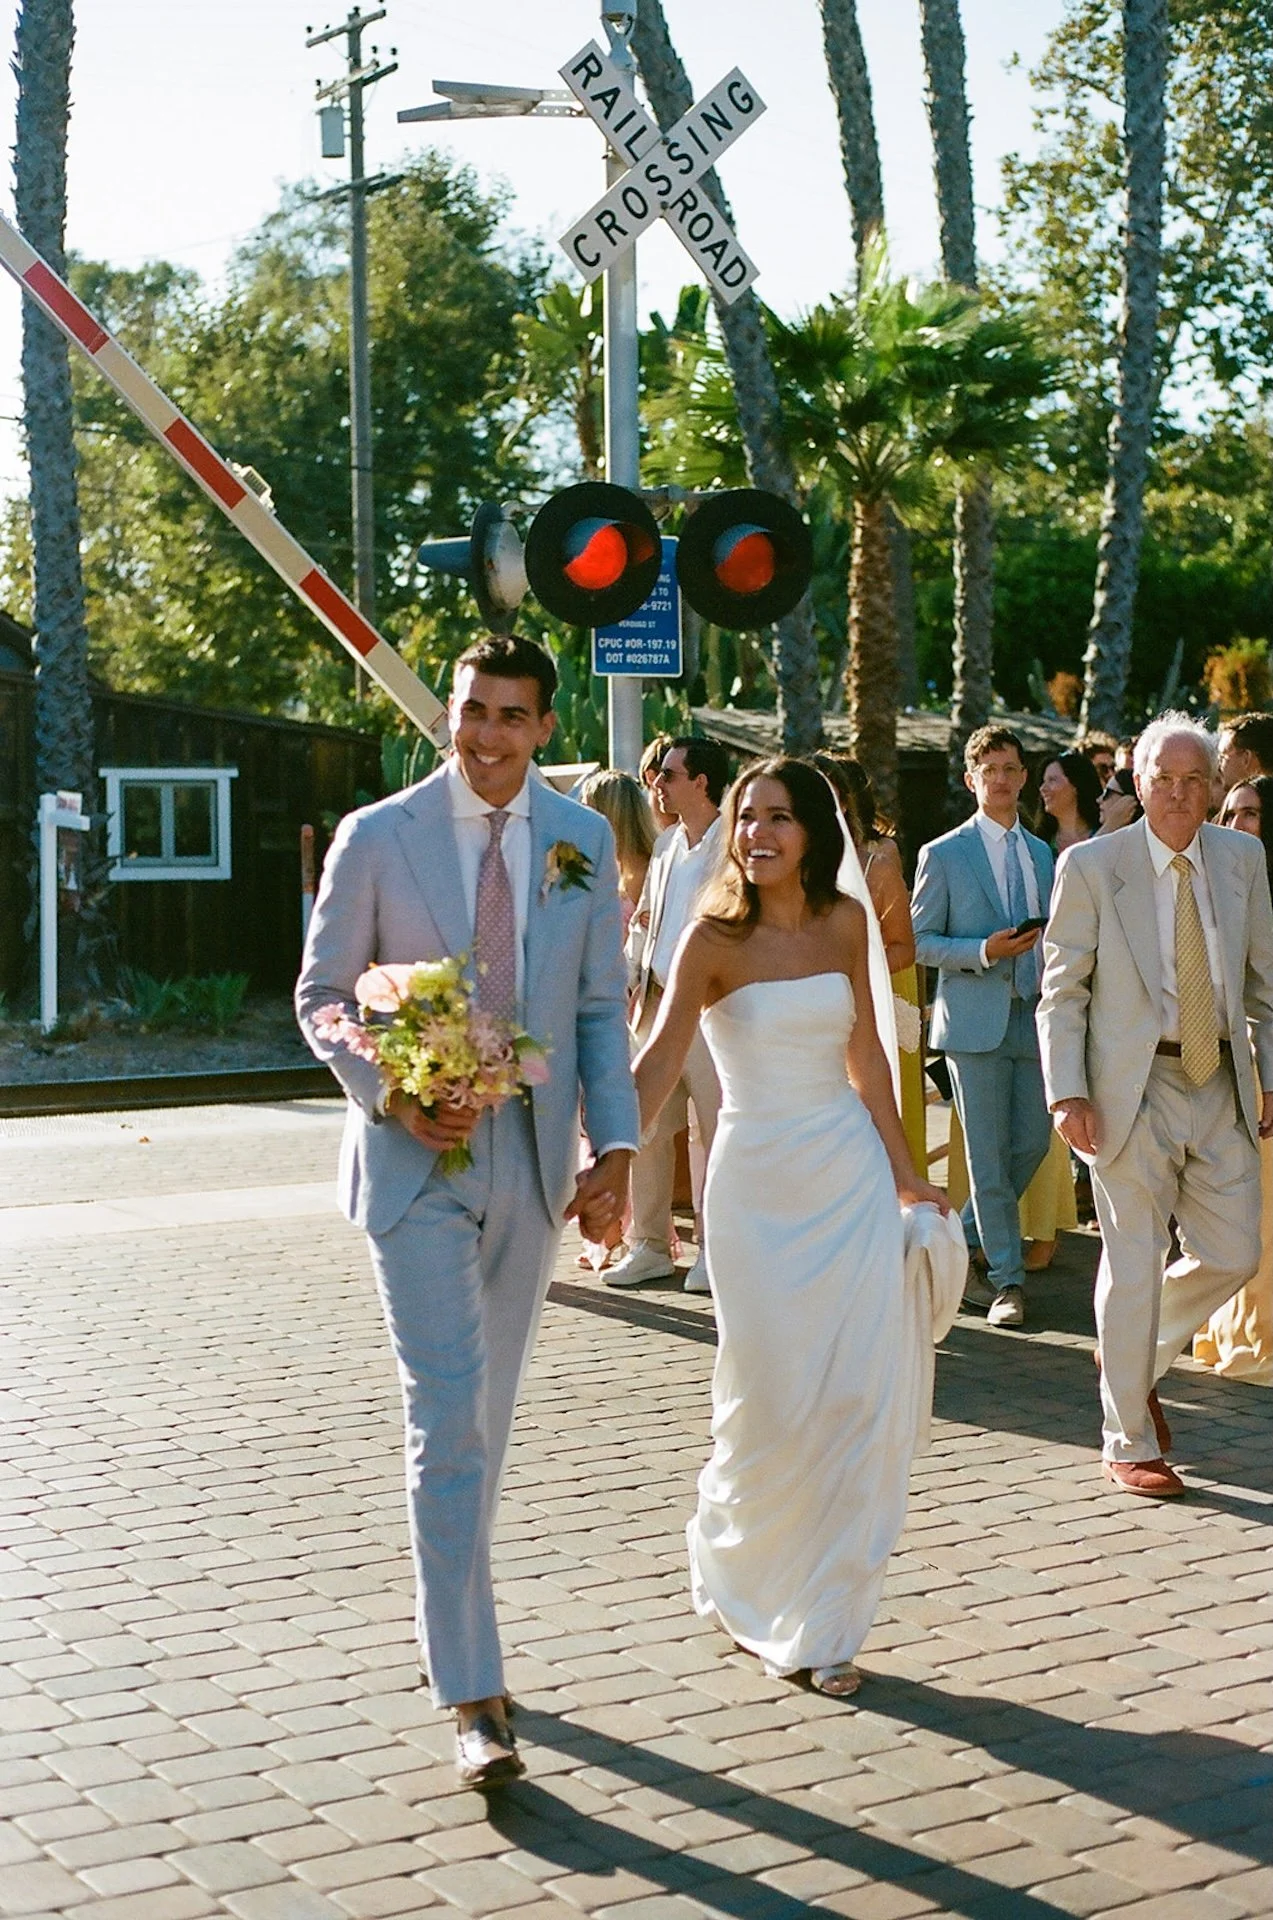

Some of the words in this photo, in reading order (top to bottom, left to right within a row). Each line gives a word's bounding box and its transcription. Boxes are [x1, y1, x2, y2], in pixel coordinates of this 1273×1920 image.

[572, 52, 647, 163] RAIL
[573, 81, 754, 268] CROSSING
[669, 188, 747, 288] ROAD
[598, 638, 623, 648] CPUC
[605, 653, 624, 664] DOT
